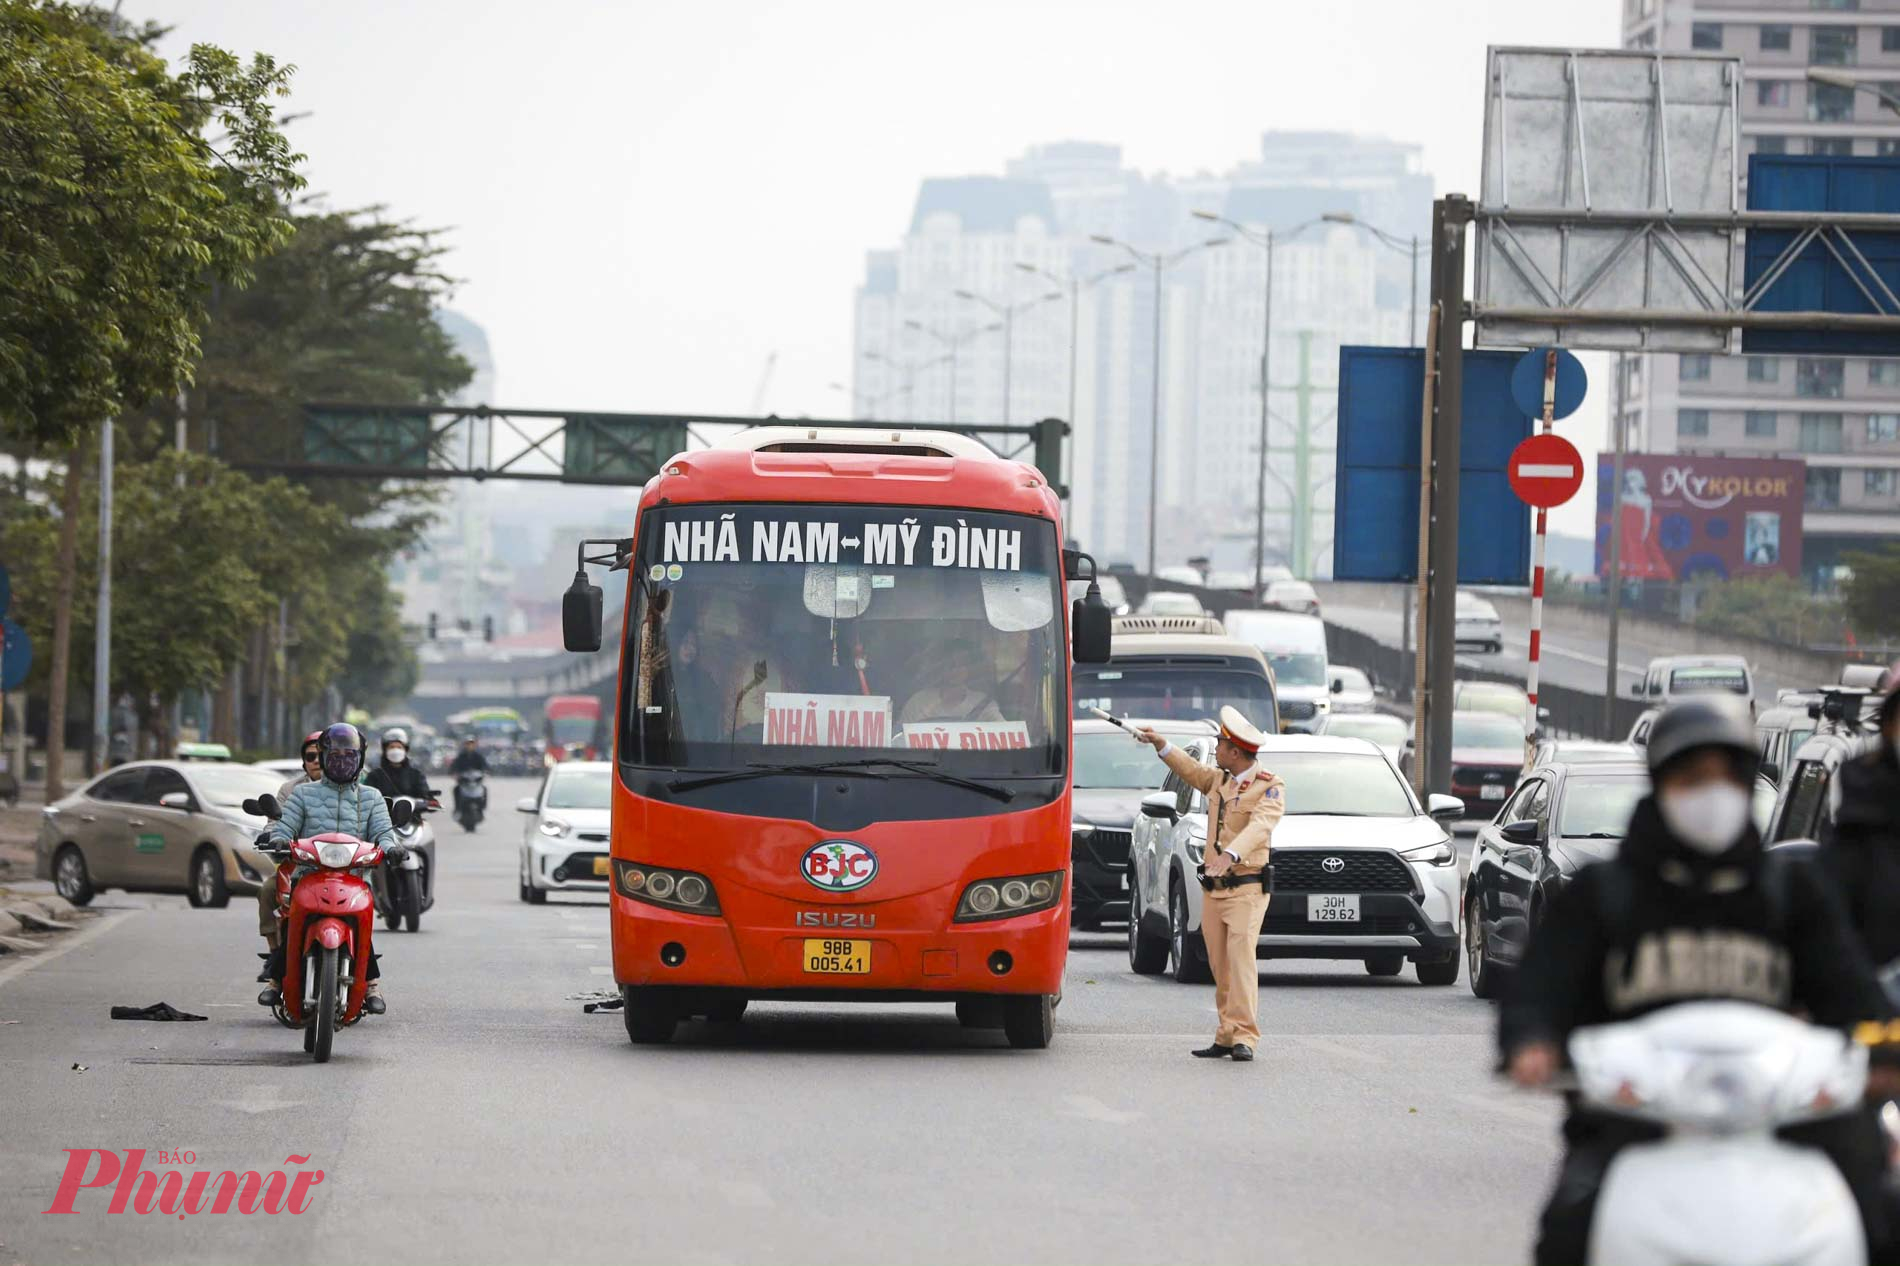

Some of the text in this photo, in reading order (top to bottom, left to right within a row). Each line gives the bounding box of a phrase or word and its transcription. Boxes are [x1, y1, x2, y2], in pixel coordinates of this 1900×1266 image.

[663, 512, 1021, 571] NHÃ NAM MỸ ĐÌNH
[767, 700, 885, 748] NHÃ NAM
[908, 727, 1026, 750] MỸ ĐÌNH
[809, 851, 869, 878] BJC
[1323, 896, 1345, 908] 30H
[796, 911, 876, 928] ISUZU
[1315, 908, 1355, 920] 129.62
[823, 941, 852, 955] 98B
[810, 956, 862, 972] 005.41
